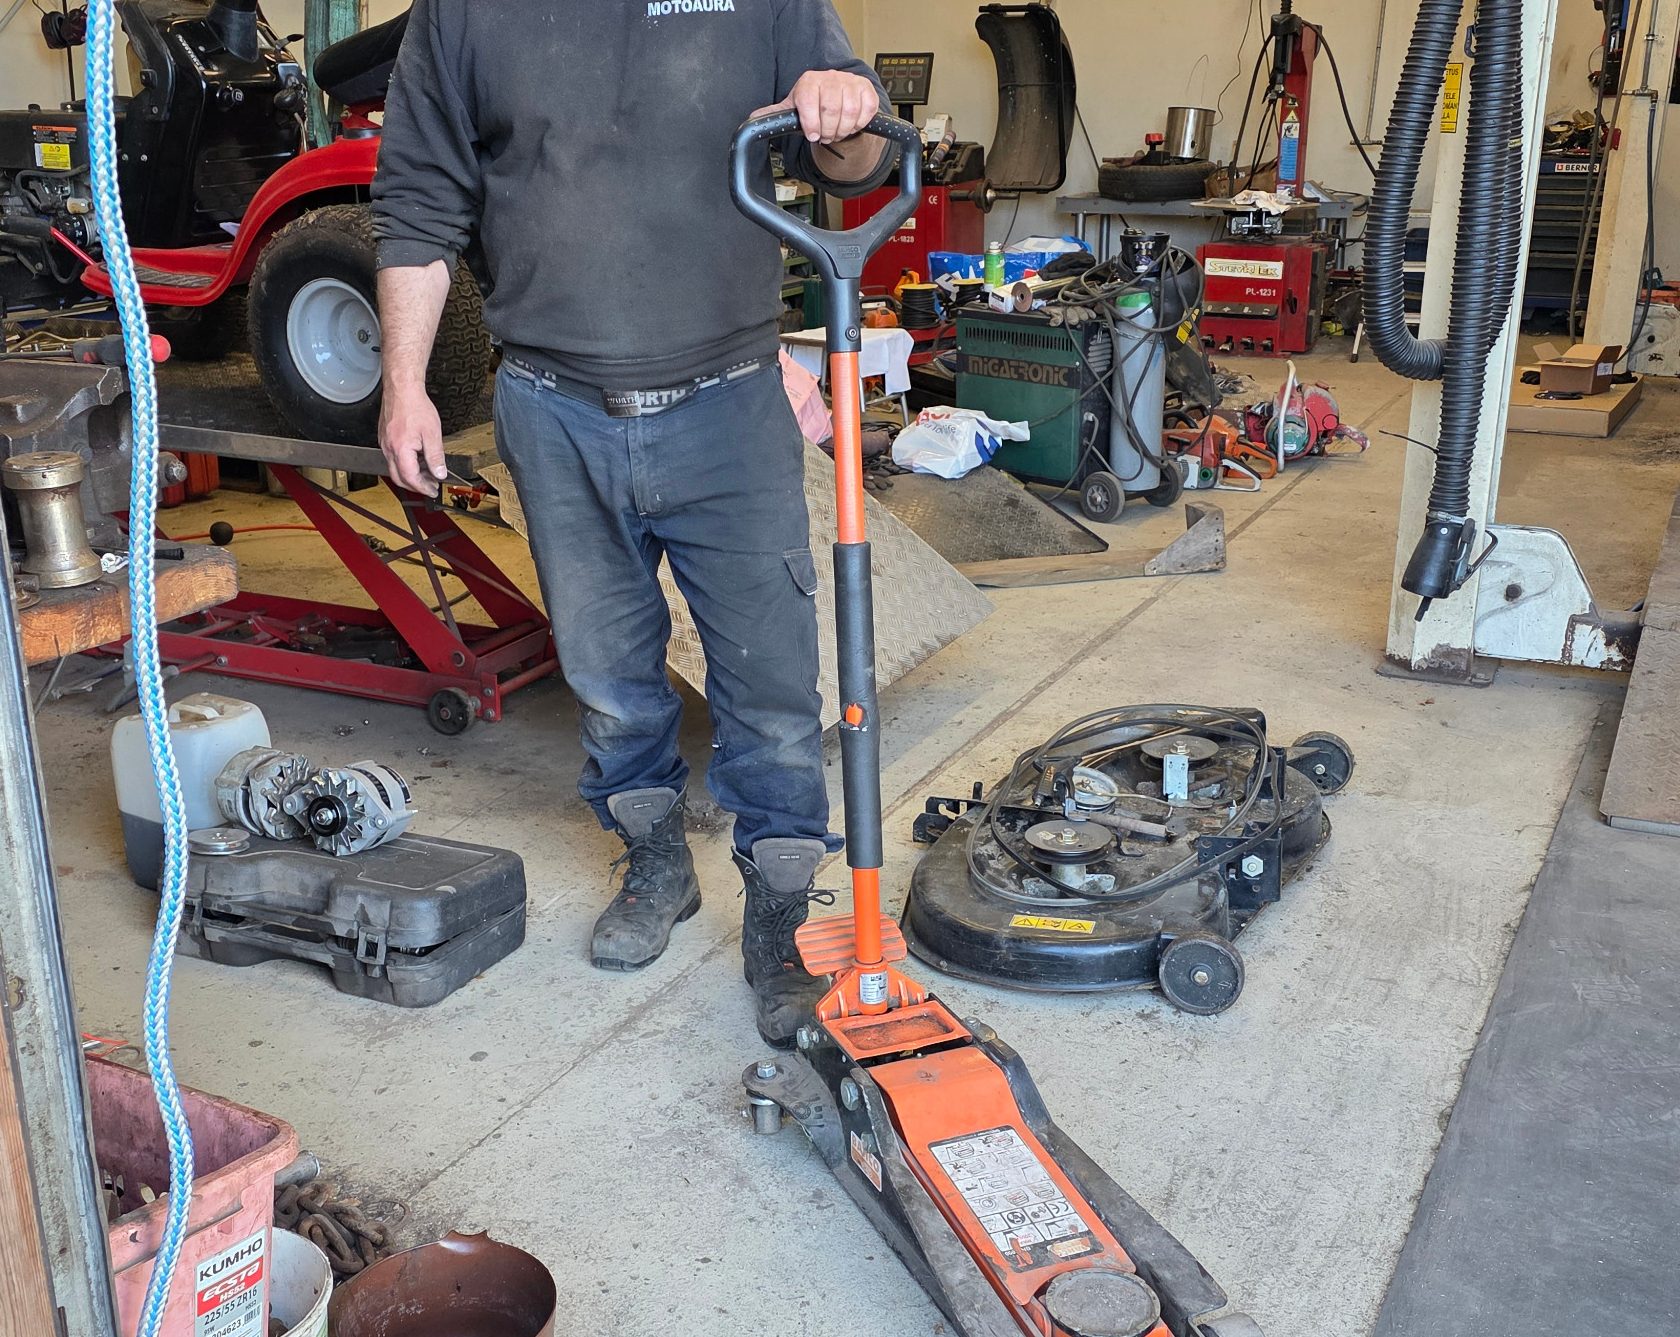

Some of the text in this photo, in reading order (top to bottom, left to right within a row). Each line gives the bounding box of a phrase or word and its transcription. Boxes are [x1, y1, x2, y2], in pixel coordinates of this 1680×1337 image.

[647, 0, 735, 16] MOTOAURA
[1245, 287, 1276, 297] PL-1231
[199, 1237, 263, 1282] KUMHO
[204, 1285, 258, 1326] 225/55 ZR16
